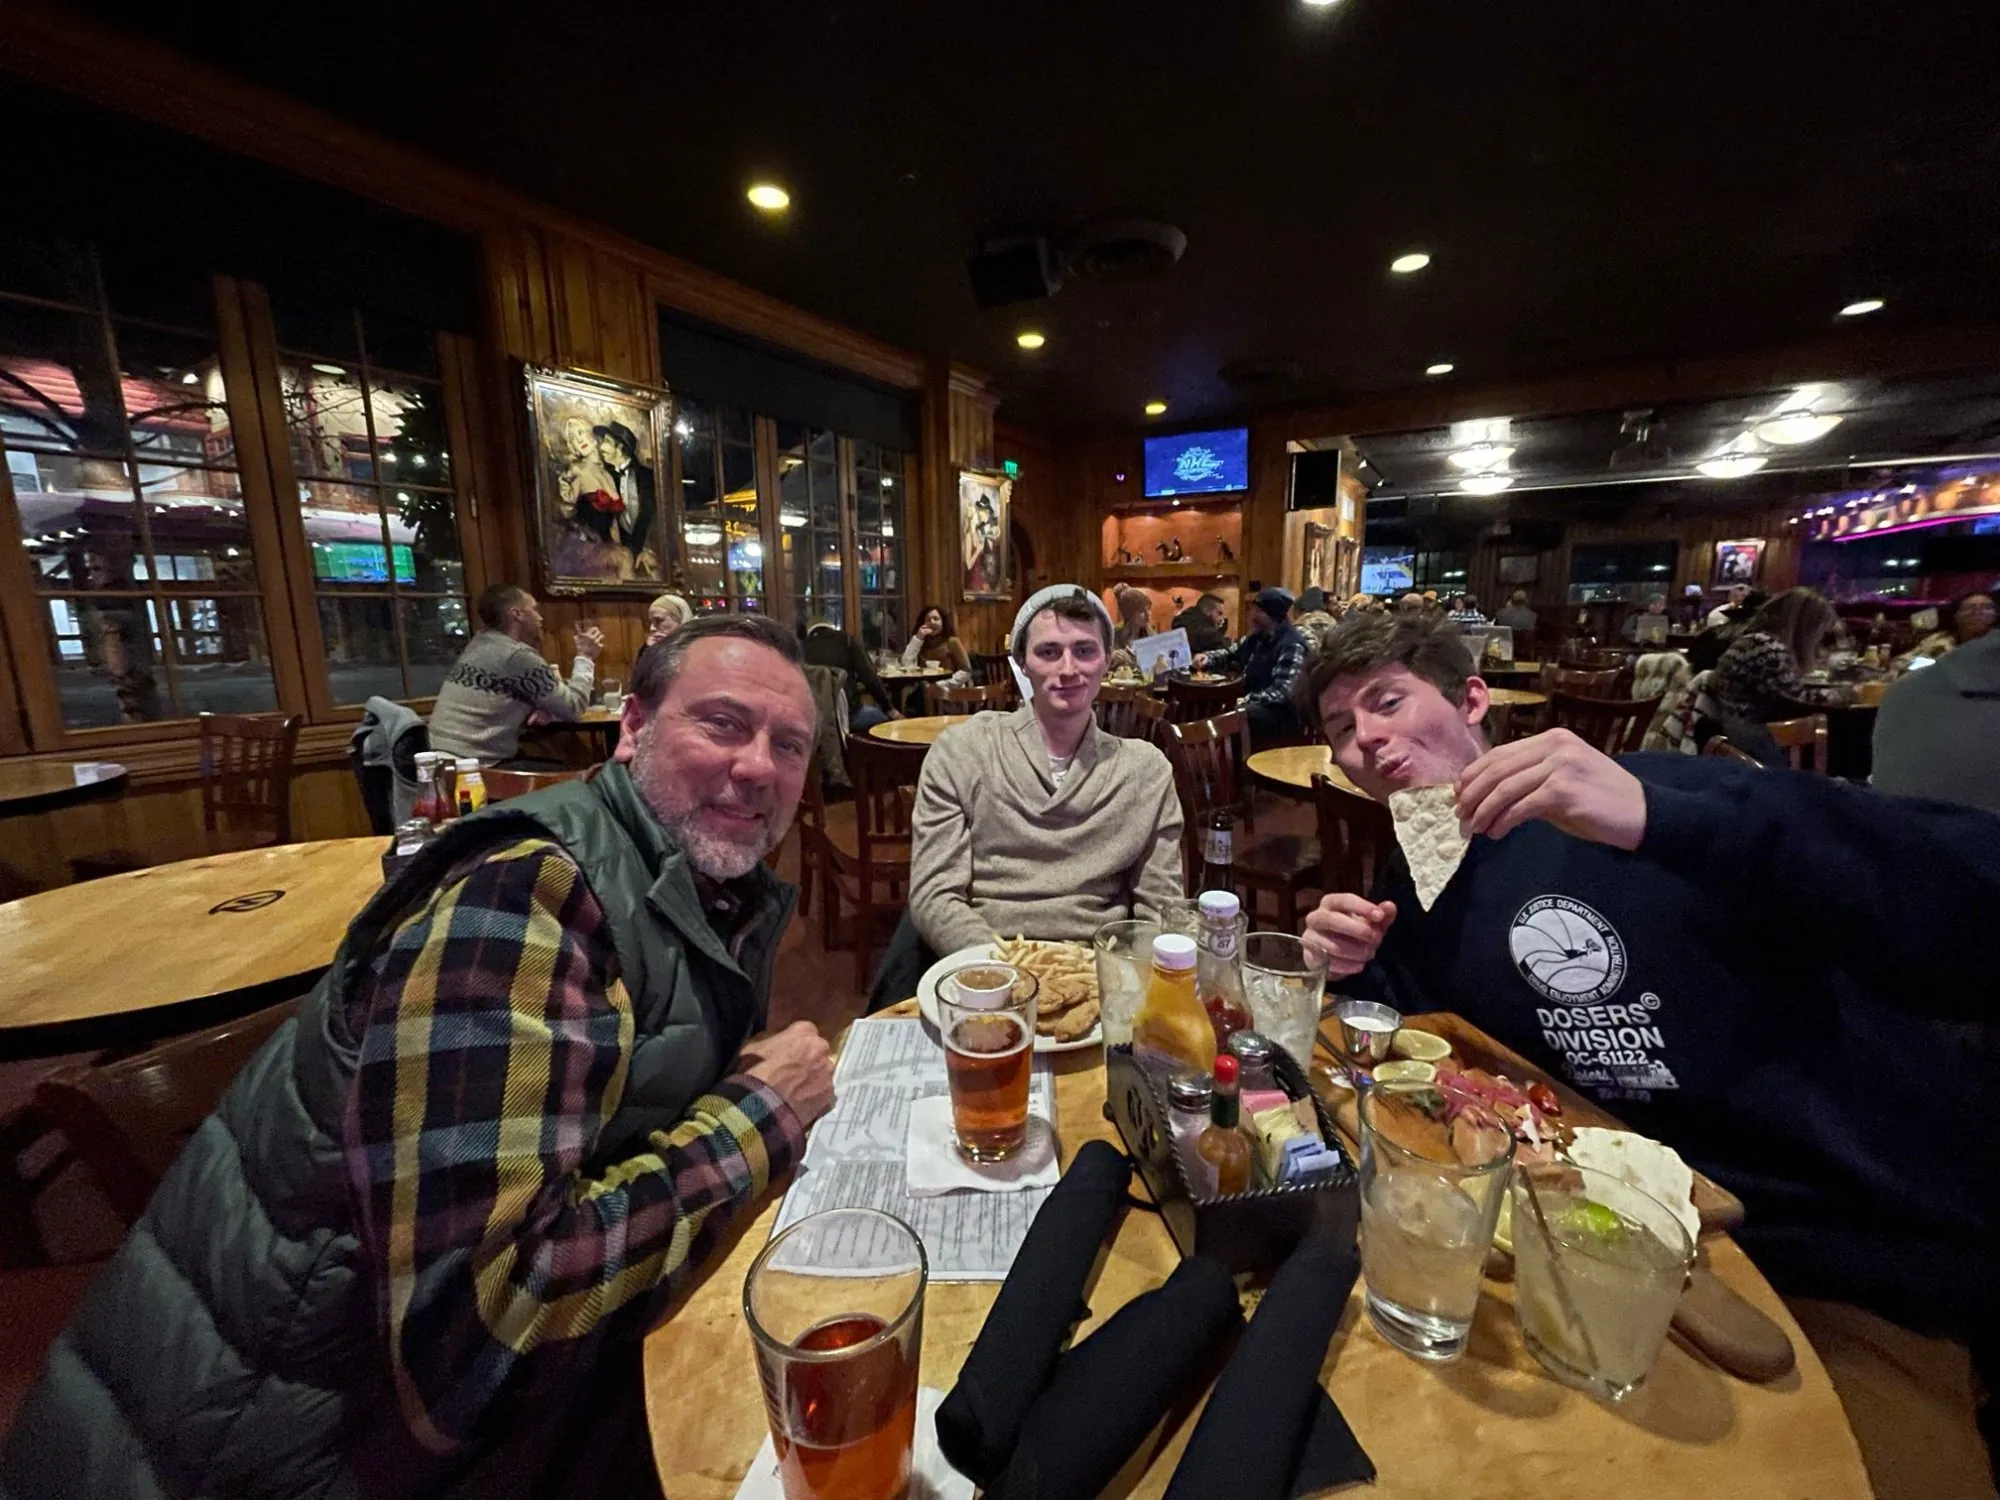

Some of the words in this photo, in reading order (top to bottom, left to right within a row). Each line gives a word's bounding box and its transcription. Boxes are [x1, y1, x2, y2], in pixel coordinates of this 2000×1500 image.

[1557, 899, 1610, 932] DEPARTMENT
[1536, 1003, 1651, 1029] DOSERS
[1543, 1026, 1666, 1051] DIVISION
